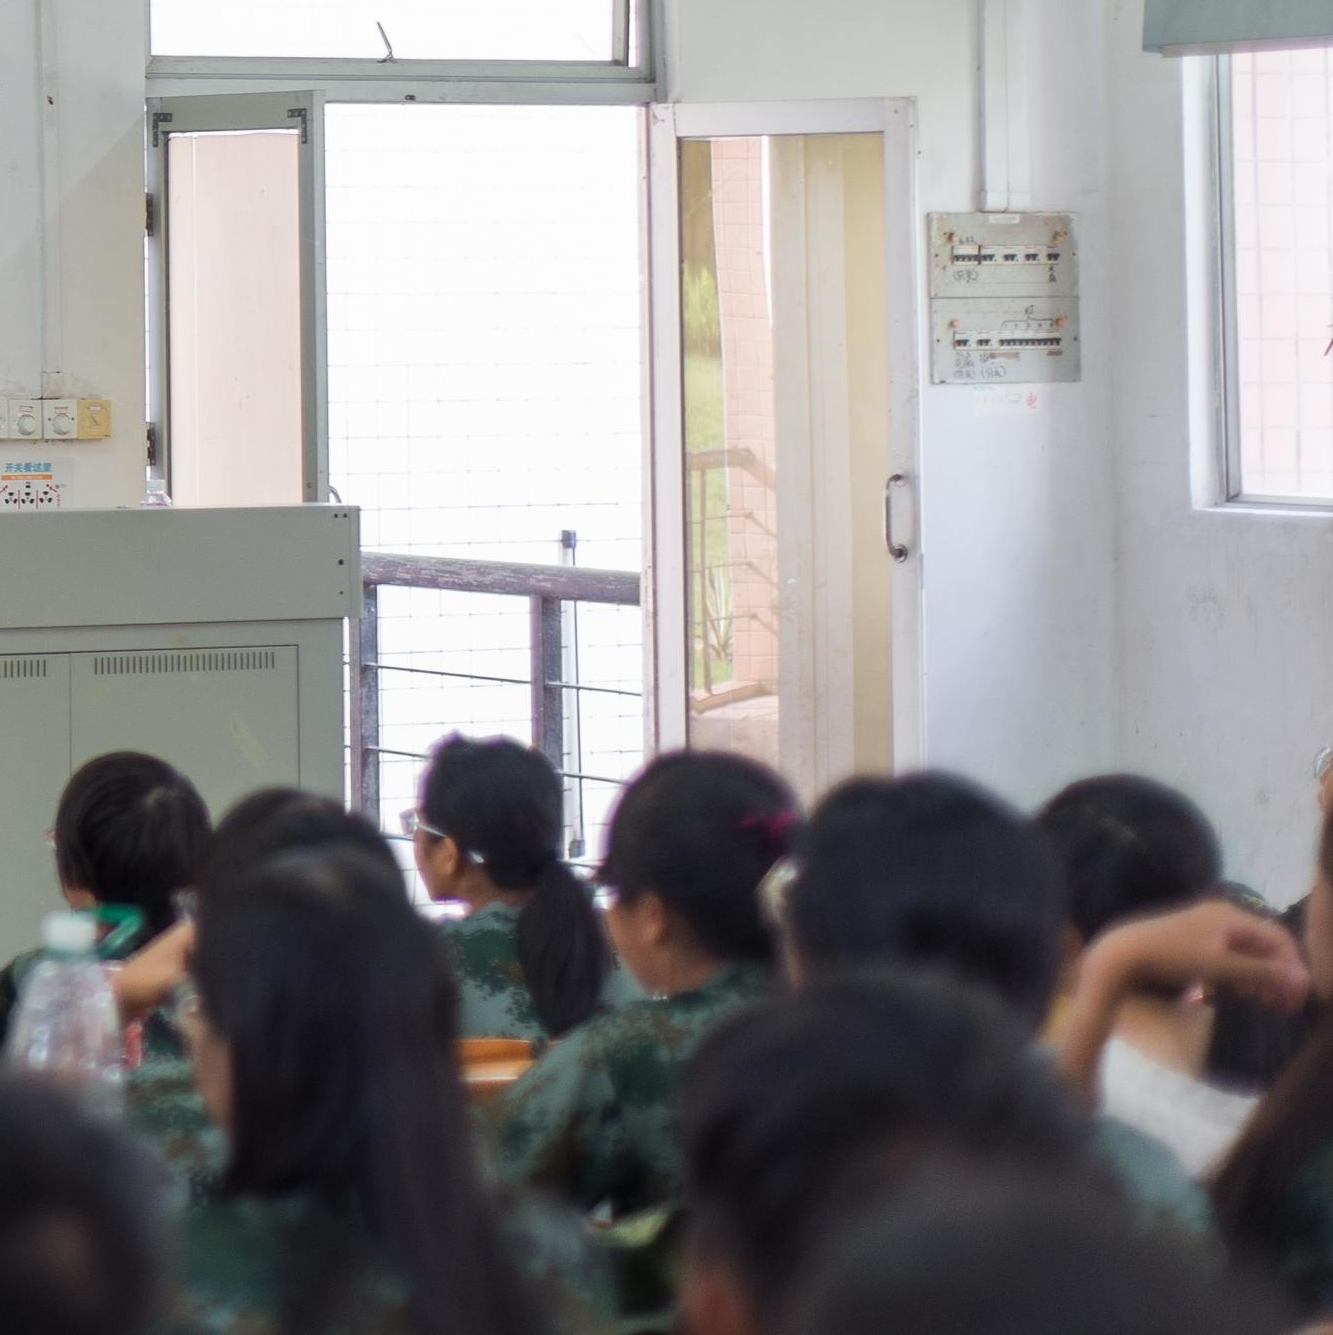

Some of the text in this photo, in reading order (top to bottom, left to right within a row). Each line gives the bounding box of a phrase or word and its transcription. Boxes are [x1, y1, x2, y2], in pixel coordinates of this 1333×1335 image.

[4, 462, 52, 473] 开关看这里
